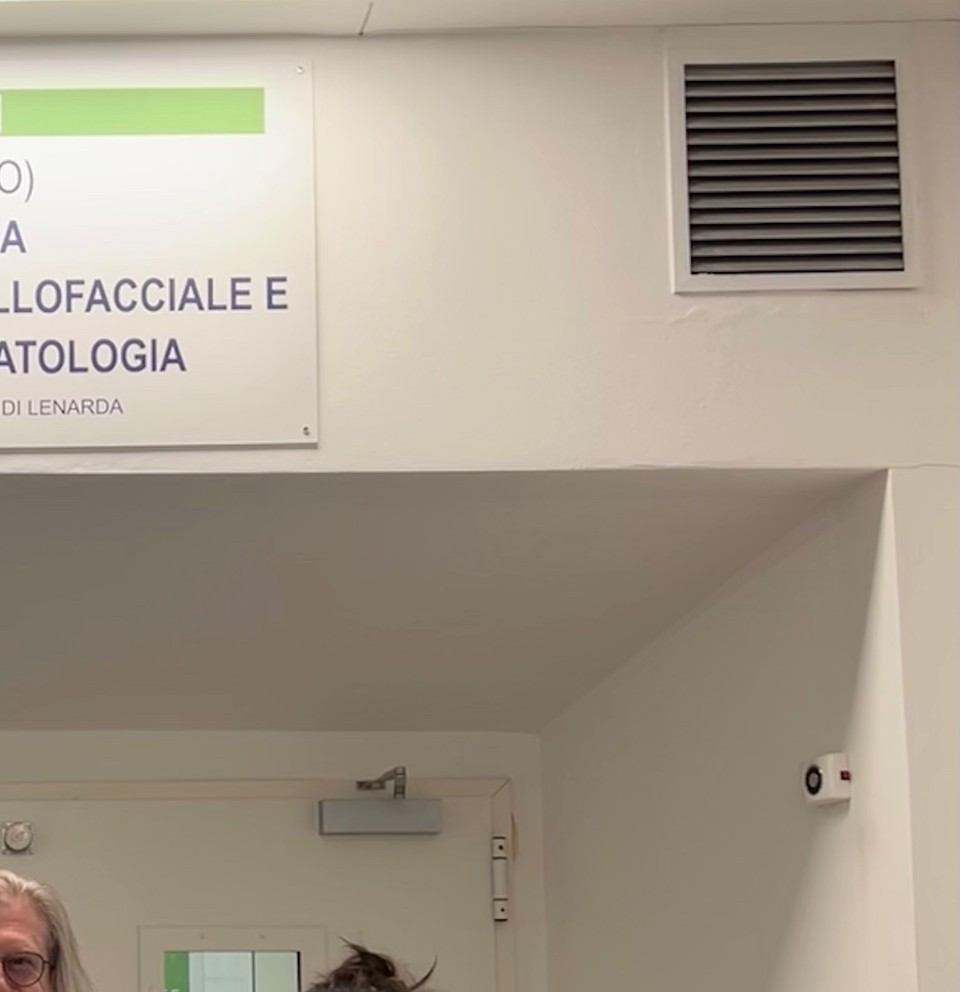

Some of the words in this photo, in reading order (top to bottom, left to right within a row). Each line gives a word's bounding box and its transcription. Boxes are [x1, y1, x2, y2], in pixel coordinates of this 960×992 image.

[266, 275, 289, 311] E
[1, 398, 22, 416] DI
[27, 397, 125, 416] LENARDA
